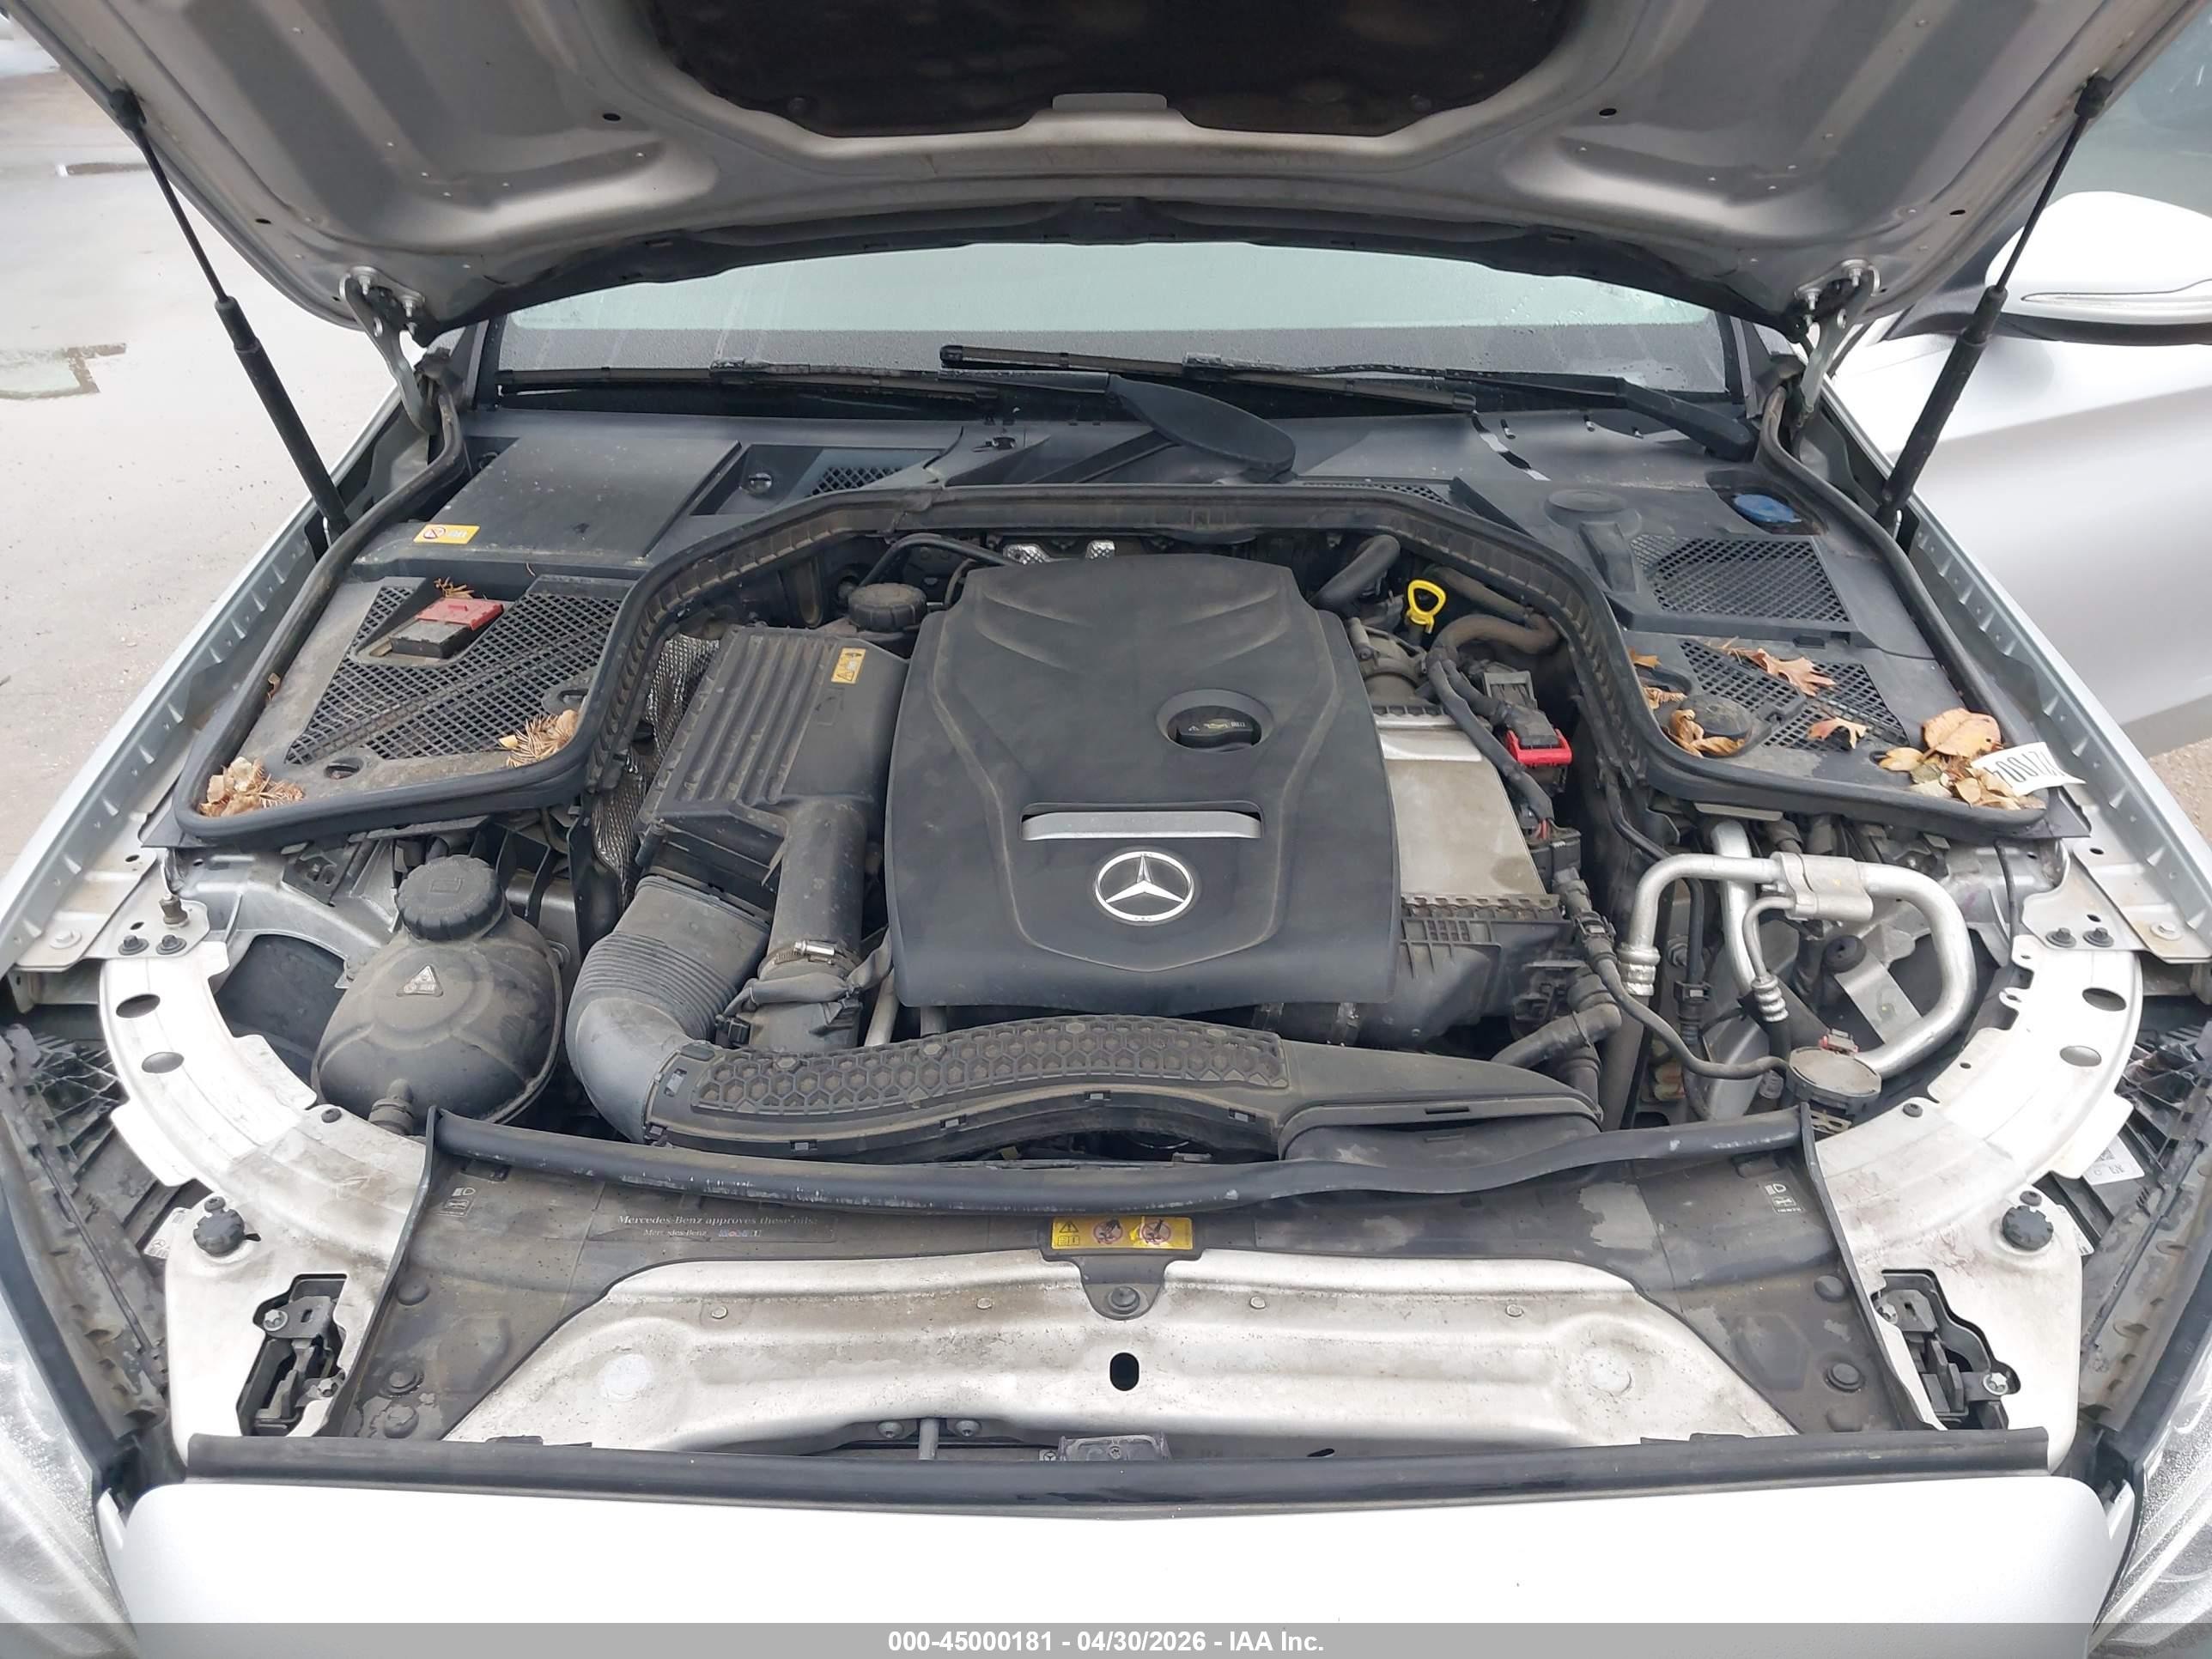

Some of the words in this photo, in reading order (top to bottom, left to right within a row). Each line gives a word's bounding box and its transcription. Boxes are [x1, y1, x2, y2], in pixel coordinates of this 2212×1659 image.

[617, 1215, 702, 1224] Mercedes-Benz
[705, 1216, 757, 1226] approves
[759, 1215, 791, 1224] these
[644, 1229, 707, 1237] Merdes-Benz
